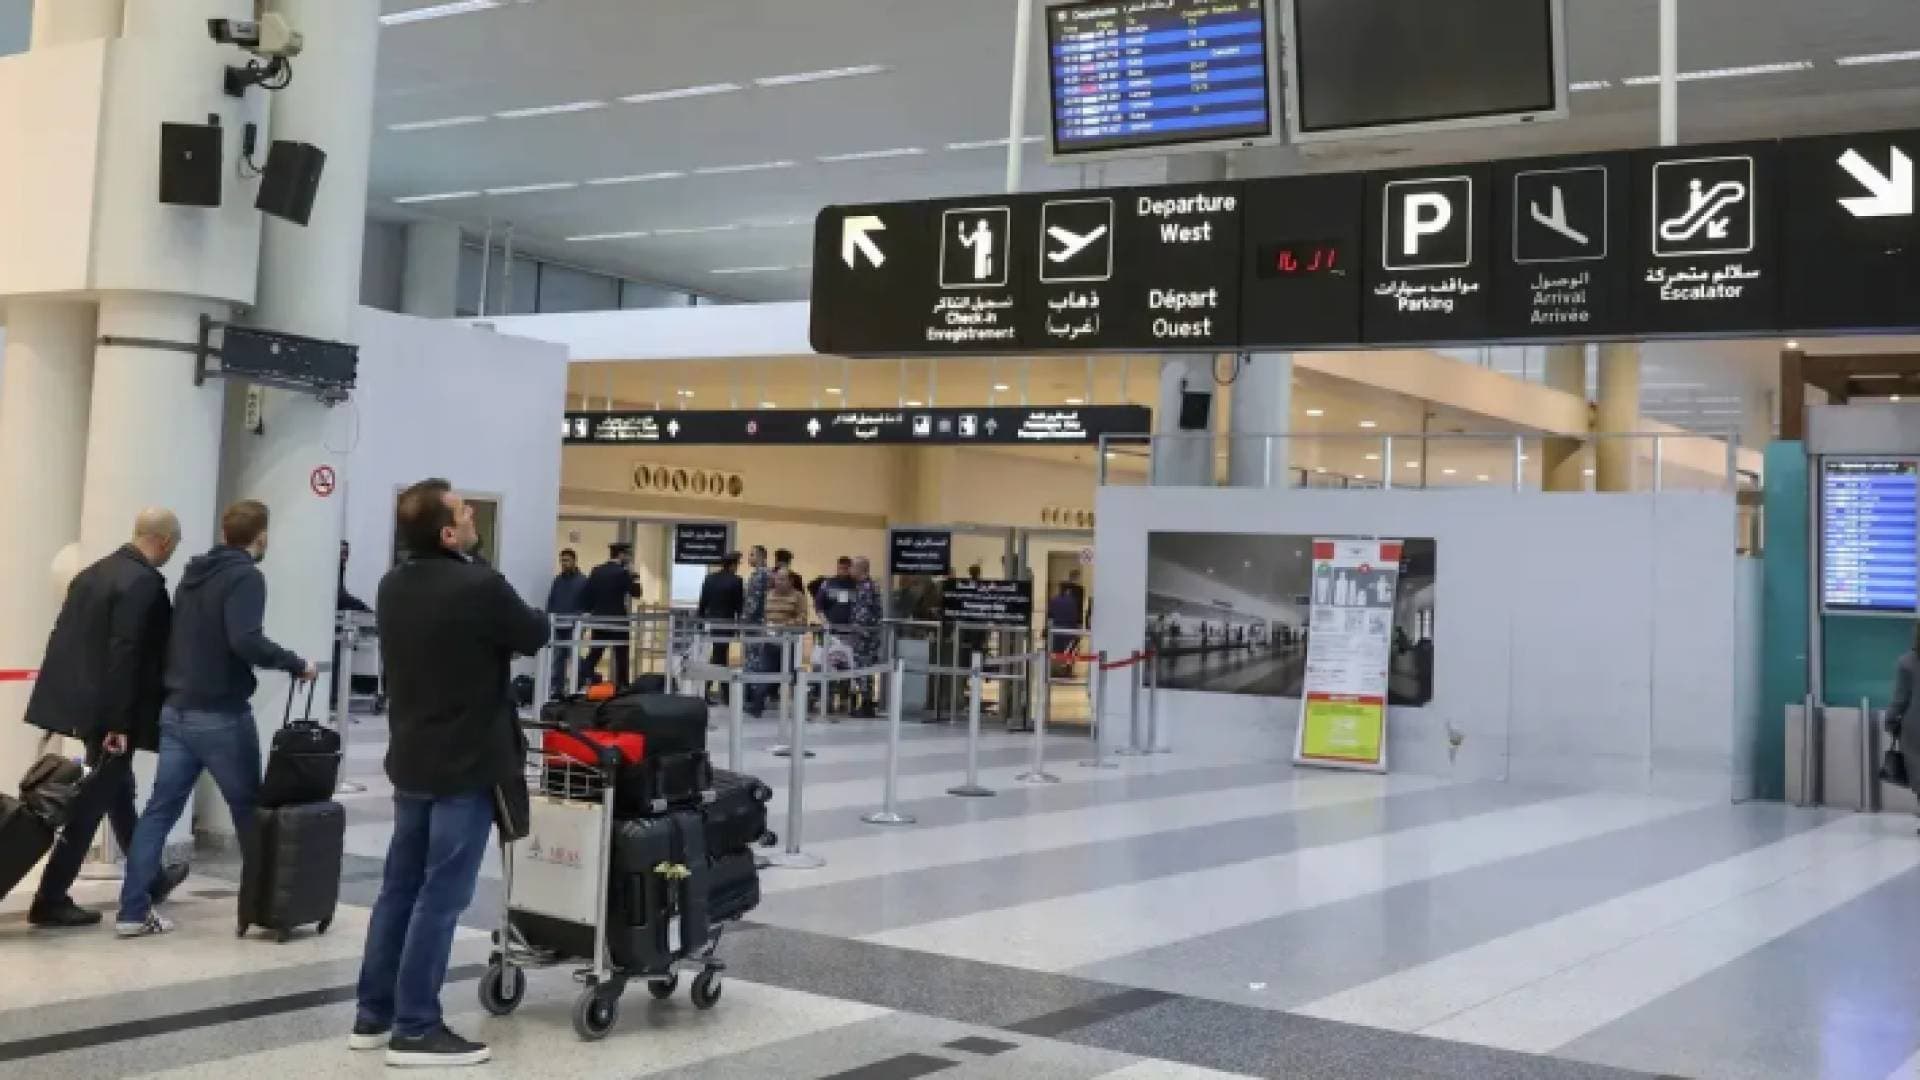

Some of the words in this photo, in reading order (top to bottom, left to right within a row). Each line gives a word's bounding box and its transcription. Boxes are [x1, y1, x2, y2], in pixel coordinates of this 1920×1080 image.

[1137, 194, 1237, 219] Departure
[1160, 220, 1213, 243] West
[1403, 193, 1452, 256] P
[1530, 271, 1590, 291] الوصول
[1711, 264, 1761, 283] سلالم
[1374, 279, 1429, 297] سيارات
[1430, 277, 1480, 295] مواقف
[1660, 283, 1745, 302] Escalator
[1047, 290, 1100, 313] ذهاب
[1149, 287, 1219, 312] Départ
[1398, 297, 1454, 314] Parking
[1533, 289, 1587, 305] Arrival
[1530, 306, 1591, 325] Arrivée
[1152, 317, 1213, 338] Ouest
